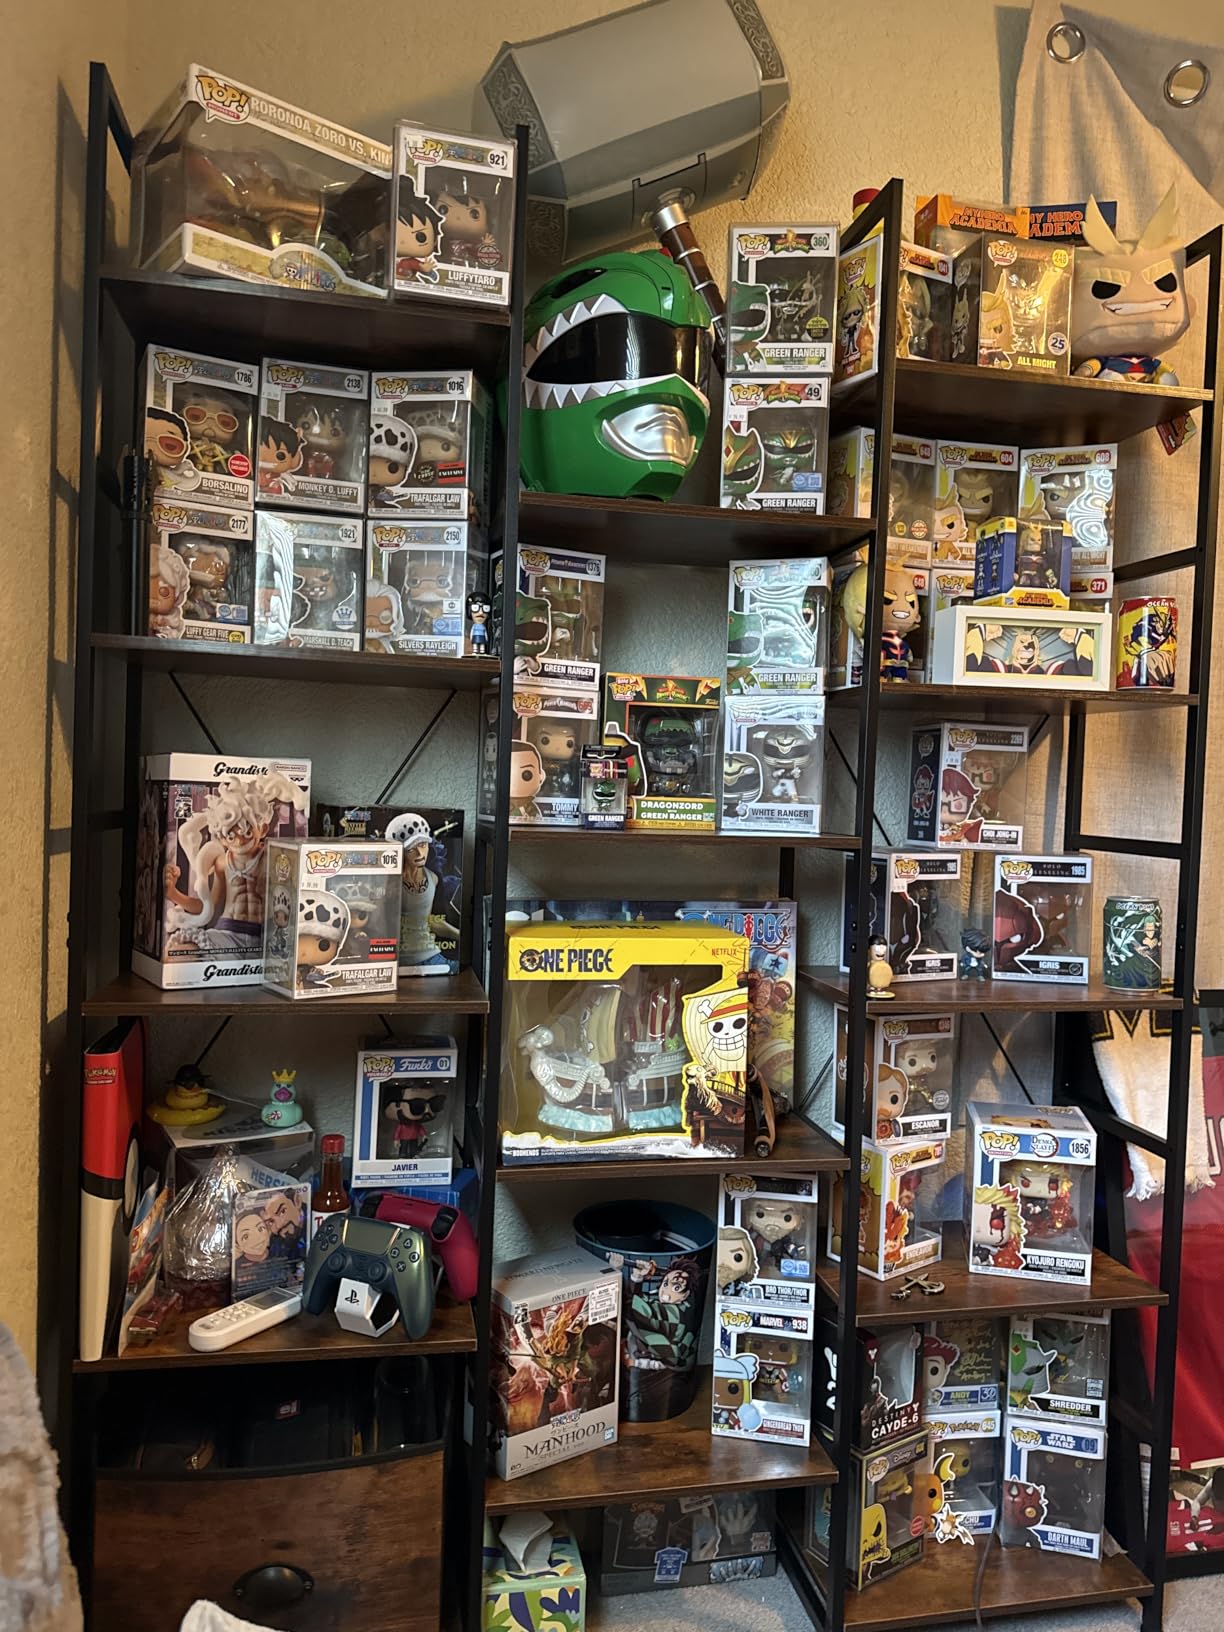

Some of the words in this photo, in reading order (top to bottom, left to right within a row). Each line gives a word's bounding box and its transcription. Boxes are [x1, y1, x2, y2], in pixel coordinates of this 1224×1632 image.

[195, 75, 249, 113] POP!
[251, 96, 312, 133] RORONOA
[315, 122, 346, 148] ZORO
[349, 139, 367, 157] VS.
[371, 149, 392, 166] KIN
[489, 154, 506, 167] 921
[949, 213, 1018, 234] ACADEMIA
[1047, 210, 1083, 223] HERO
[1029, 221, 1082, 238] ADEM
[736, 233, 769, 250] POP!
[813, 236, 828, 247] 360
[988, 240, 1017, 258] POP!
[448, 270, 496, 286] LUFFYTARO
[1051, 337, 1065, 350] 25
[764, 348, 791, 358] GREEN
[792, 348, 825, 358] RANGER
[154, 352, 192, 374] POP!
[1017, 356, 1031, 366] ALL
[1032, 358, 1056, 369] MIGHT
[266, 364, 304, 384] POP!
[346, 378, 361, 390] 2138
[375, 377, 408, 396] POP!
[447, 380, 464, 392] 1016
[730, 384, 764, 401] POP!
[806, 387, 820, 398] 49
[938, 445, 967, 461] POP!
[1025, 453, 1056, 471] POP!
[202, 478, 248, 494] BORSALINO
[298, 482, 327, 493] MONKEY
[336, 485, 358, 496] LUFFY
[410, 493, 446, 504] TRAFALGAR
[446, 494, 461, 504] LAW
[762, 498, 786, 508] GREEN
[787, 498, 816, 508] RANGER
[153, 503, 187, 524] POP!
[231, 517, 246, 531] 2177
[340, 528, 355, 539] 1921
[373, 525, 406, 545] POP!
[445, 530, 460, 541] 2150
[519, 550, 550, 568] POP!
[937, 574, 965, 592] POP!
[1091, 580, 1105, 592] 371
[186, 626, 202, 636] LUFFY
[202, 627, 217, 637] GEAR
[217, 629, 229, 638] FIVE
[338, 638, 354, 647] TEACH
[398, 640, 424, 650] SILVERS
[425, 641, 456, 651] RAYLEIGH
[544, 663, 567, 674] GREEN
[567, 665, 594, 677] RANGER
[758, 673, 783, 682] GREEN
[784, 673, 817, 682] RANGER
[609, 684, 636, 698] POP!
[513, 693, 541, 709] POP!
[949, 728, 977, 744] POP!
[551, 802, 578, 812] TOMMY
[640, 800, 703, 810] DRAGONZORD
[588, 814, 604, 823] GREEN
[604, 814, 624, 823] RANGER
[641, 812, 667, 820] GREEN
[669, 812, 703, 821] RANGER
[752, 808, 775, 818] WHITE
[777, 809, 809, 818] RANGER
[306, 849, 342, 870] POP!
[382, 854, 398, 865] 1016
[895, 858, 919, 875] POP!
[1000, 861, 1032, 876] POP!
[711, 948, 737, 956] NETFLIX
[519, 948, 565, 973] ONE
[567, 948, 614, 973] PIECE
[1039, 961, 1060, 970] IGRIS
[342, 969, 377, 980] TRAFALGAR
[378, 968, 393, 979] LAW
[883, 1020, 908, 1036] POP!
[363, 1057, 395, 1072] POP!
[399, 1058, 434, 1071] Funko
[911, 1120, 940, 1130] ESCANOR
[979, 1131, 1019, 1151] POP!
[1071, 1142, 1089, 1155] 1856
[392, 1163, 418, 1172] JAVIER
[890, 1153, 911, 1169] POP!
[723, 1174, 756, 1193] POP!
[1026, 1254, 1055, 1267] KYOJURO
[1055, 1257, 1085, 1270] RENGOKU
[552, 1293, 567, 1303] ONE
[567, 1287, 587, 1300] PIECE
[777, 1285, 808, 1298] THOR/THOR
[720, 1311, 751, 1328] POP!
[760, 1316, 784, 1328] MARVEL
[792, 1319, 807, 1331] 938
[950, 1390, 970, 1400] ANDY
[1049, 1399, 1092, 1412] SHREDDER
[871, 1402, 920, 1427] DESTINY
[871, 1412, 919, 1440] CAYDE-6
[523, 1421, 606, 1460] MANHOOD
[1011, 1428, 1042, 1445] POP!
[1046, 1438, 1076, 1449] WARS
[1047, 1433, 1075, 1443] STAR
[1085, 1439, 1097, 1453] 09
[867, 1460, 889, 1477] POP!
[1047, 1532, 1069, 1544] DARTH
[1070, 1535, 1088, 1547] MAUL
